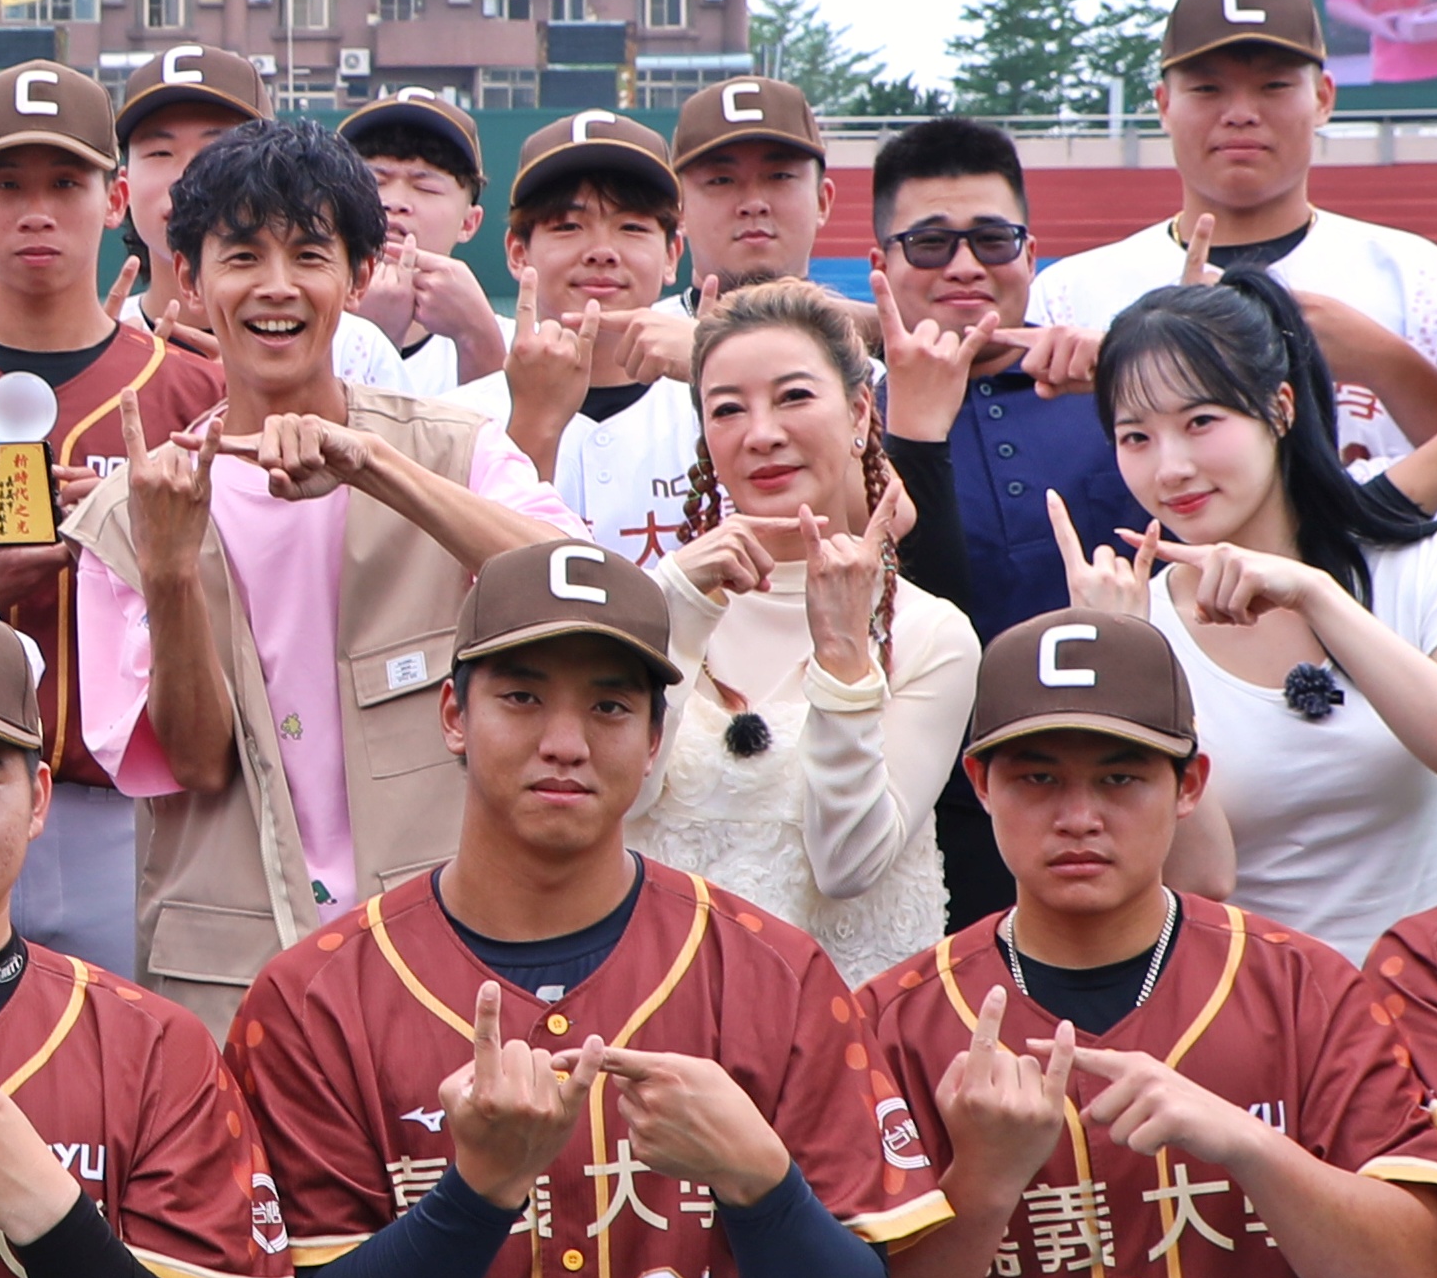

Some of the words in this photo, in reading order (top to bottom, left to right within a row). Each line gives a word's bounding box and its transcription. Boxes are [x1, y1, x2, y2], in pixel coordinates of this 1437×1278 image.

[163, 45, 204, 84] C
[15, 70, 59, 114] C
[721, 82, 763, 122] C
[549, 544, 607, 603] C
[1038, 624, 1098, 687] C
